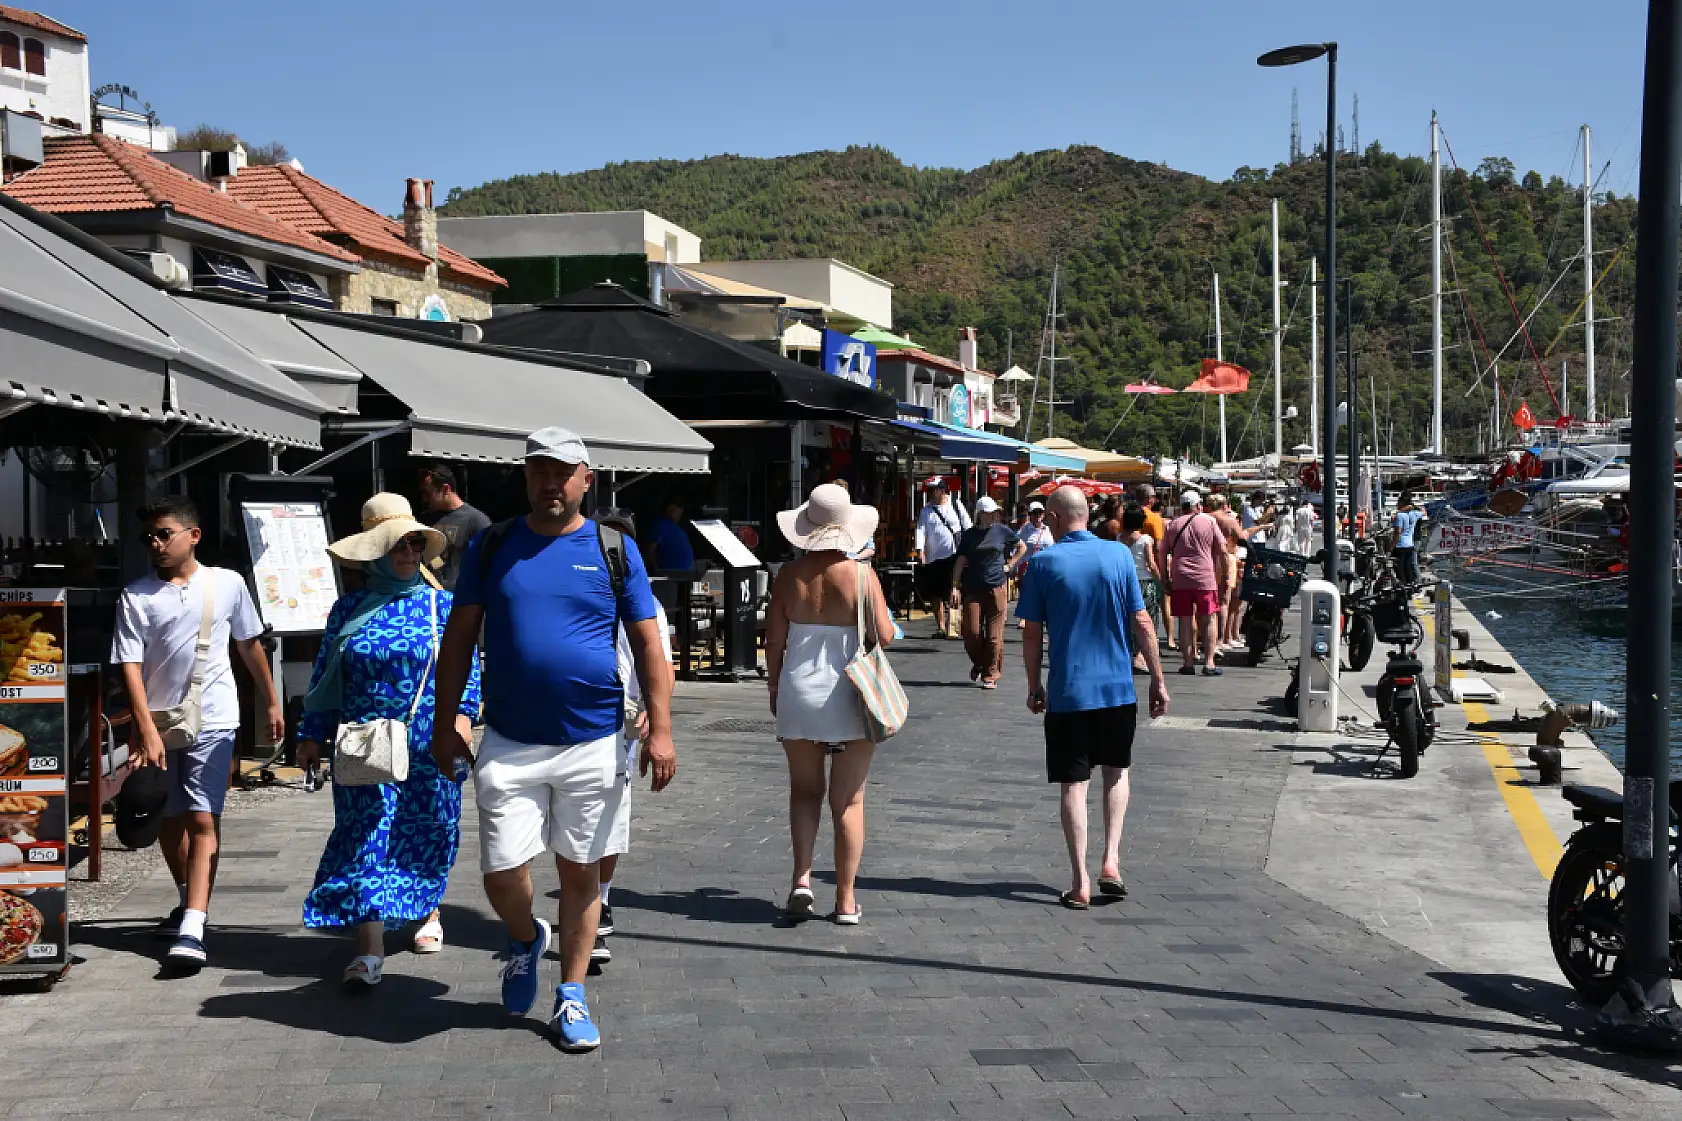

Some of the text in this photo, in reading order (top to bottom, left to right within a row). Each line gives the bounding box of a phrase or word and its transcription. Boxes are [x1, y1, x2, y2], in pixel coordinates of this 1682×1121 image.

[30, 664, 55, 676] 350
[31, 757, 57, 769] 200
[30, 850, 56, 860] 250
